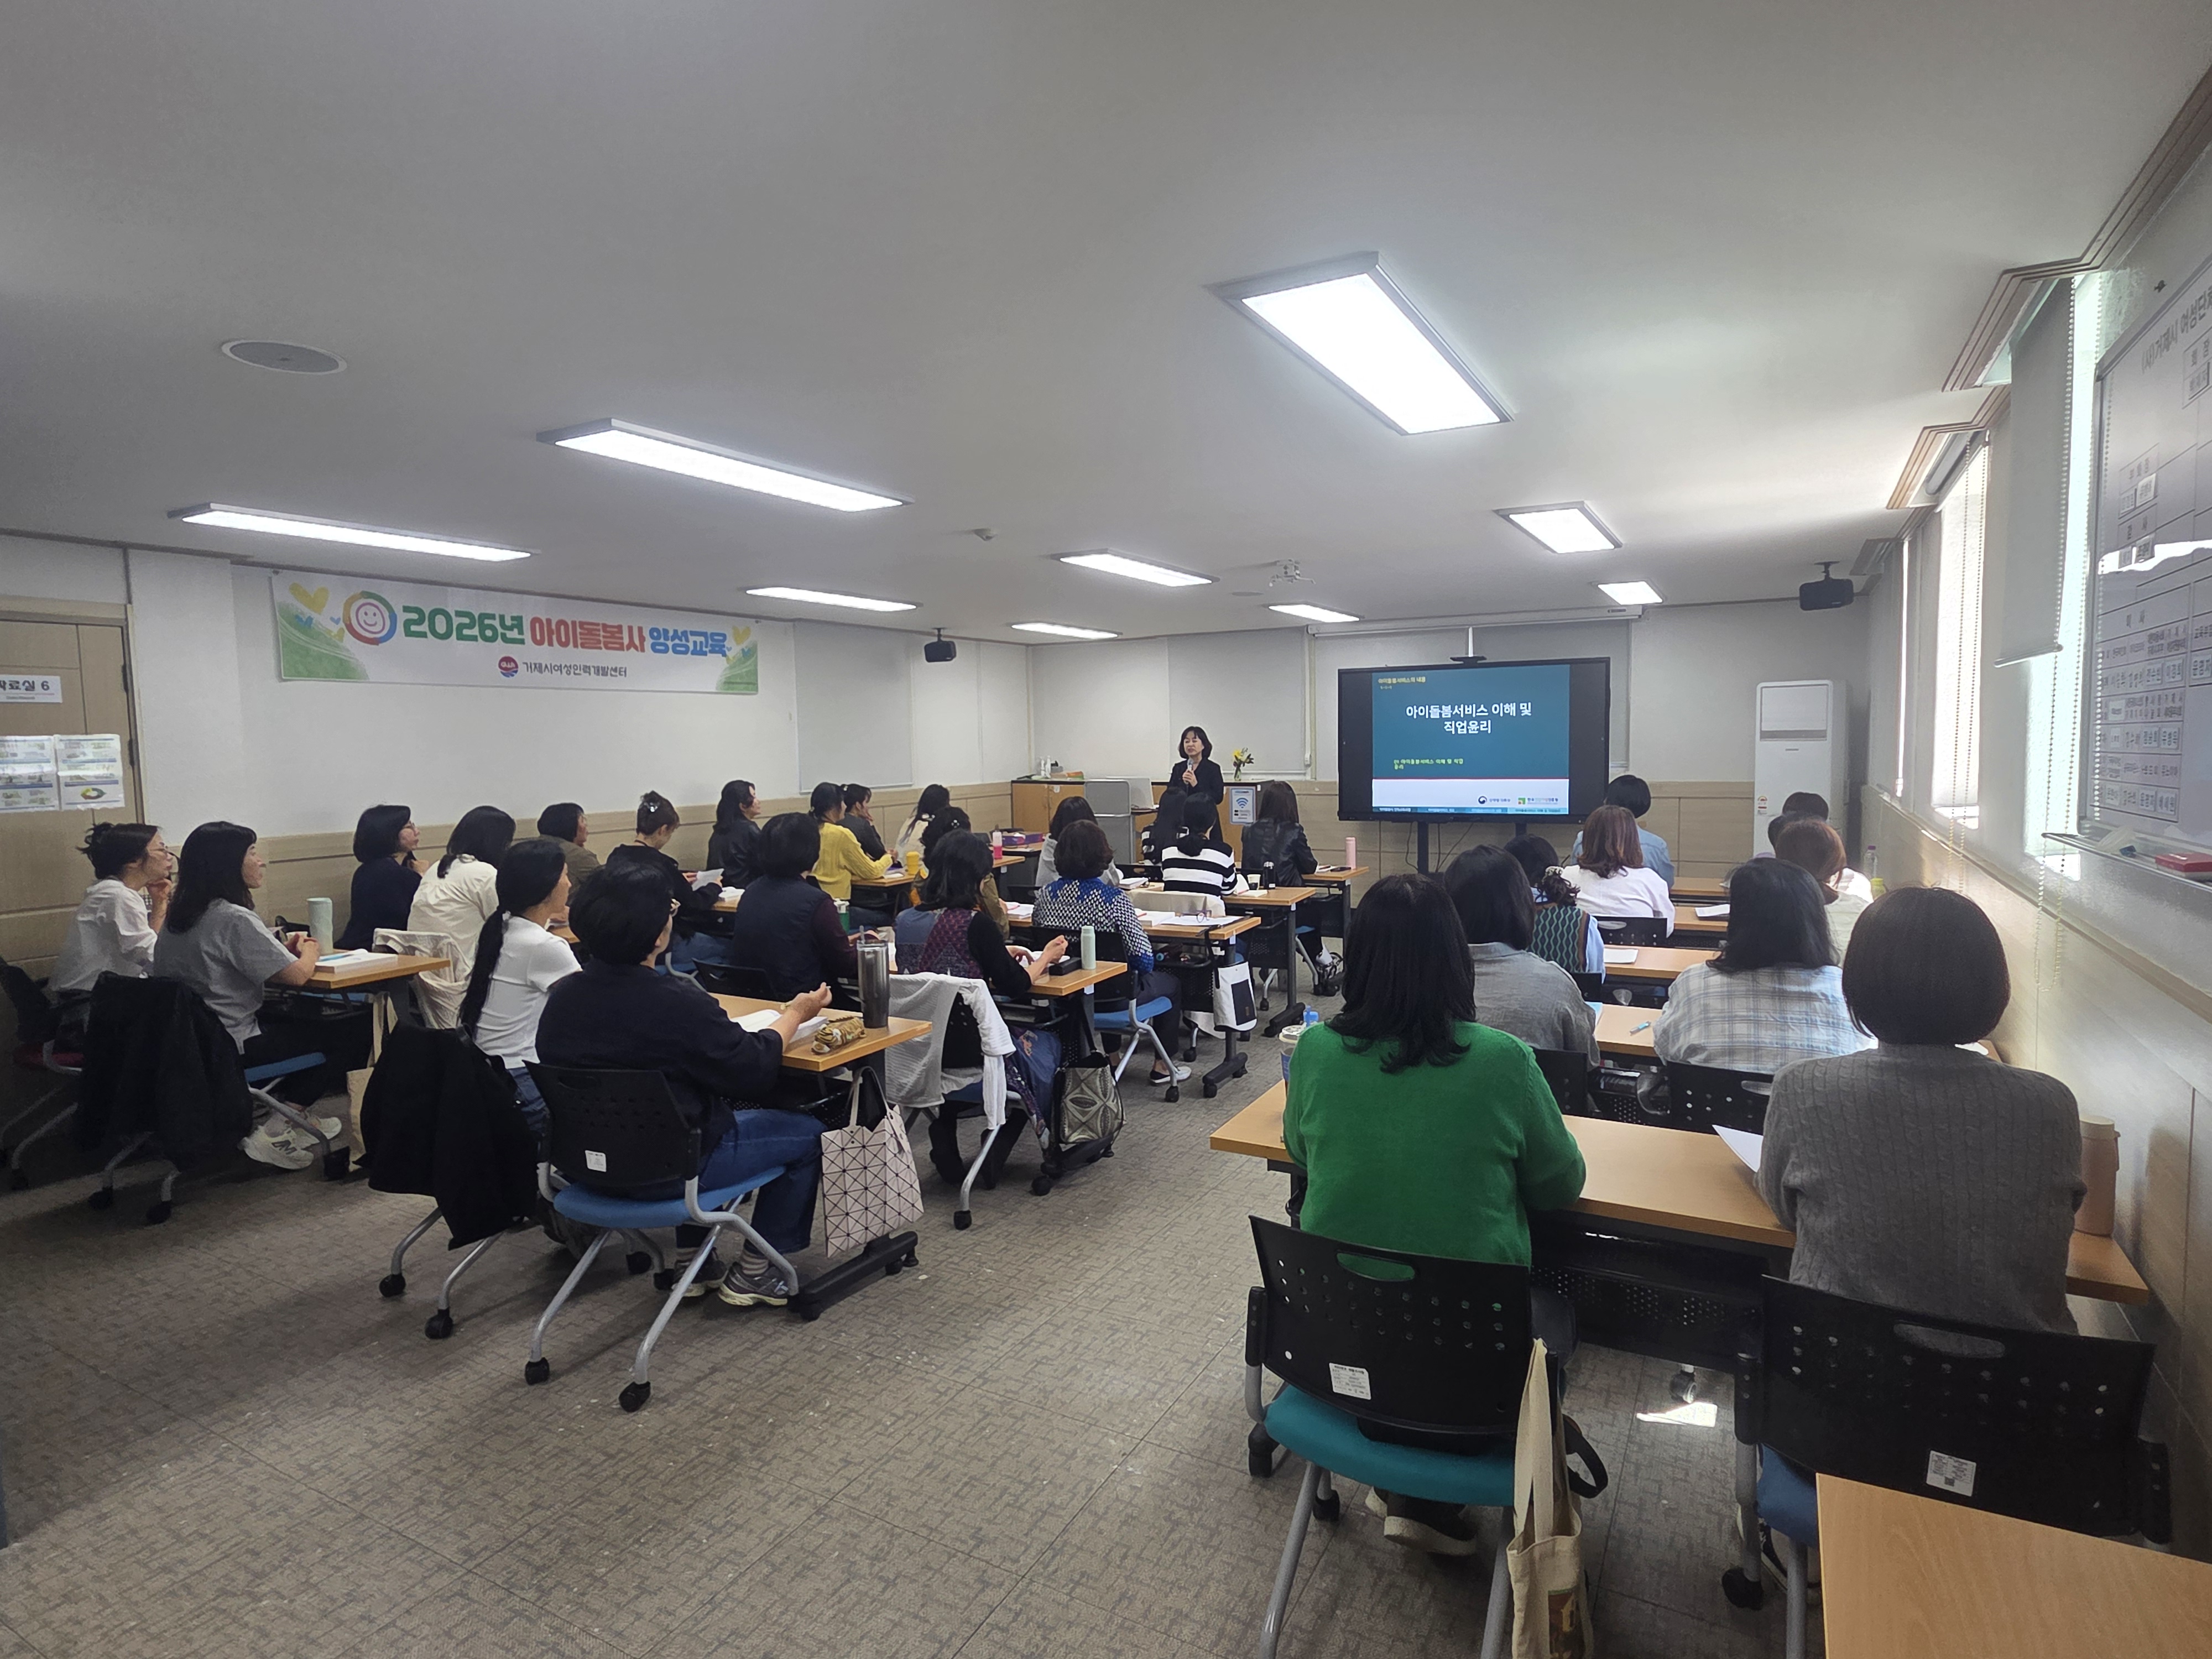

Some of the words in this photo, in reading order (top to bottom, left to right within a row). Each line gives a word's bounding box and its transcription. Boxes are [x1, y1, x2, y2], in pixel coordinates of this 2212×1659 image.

[402, 605, 525, 645] 2026년
[530, 616, 646, 653] 아이돌봄사
[649, 627, 727, 657] 양성교육
[41, 680, 50, 691] 6
[1406, 704, 1489, 719] 아이돌봄서비스
[1491, 702, 1516, 717] 이해
[1520, 702, 1532, 716] 및
[1443, 719, 1491, 734] 직업윤리
